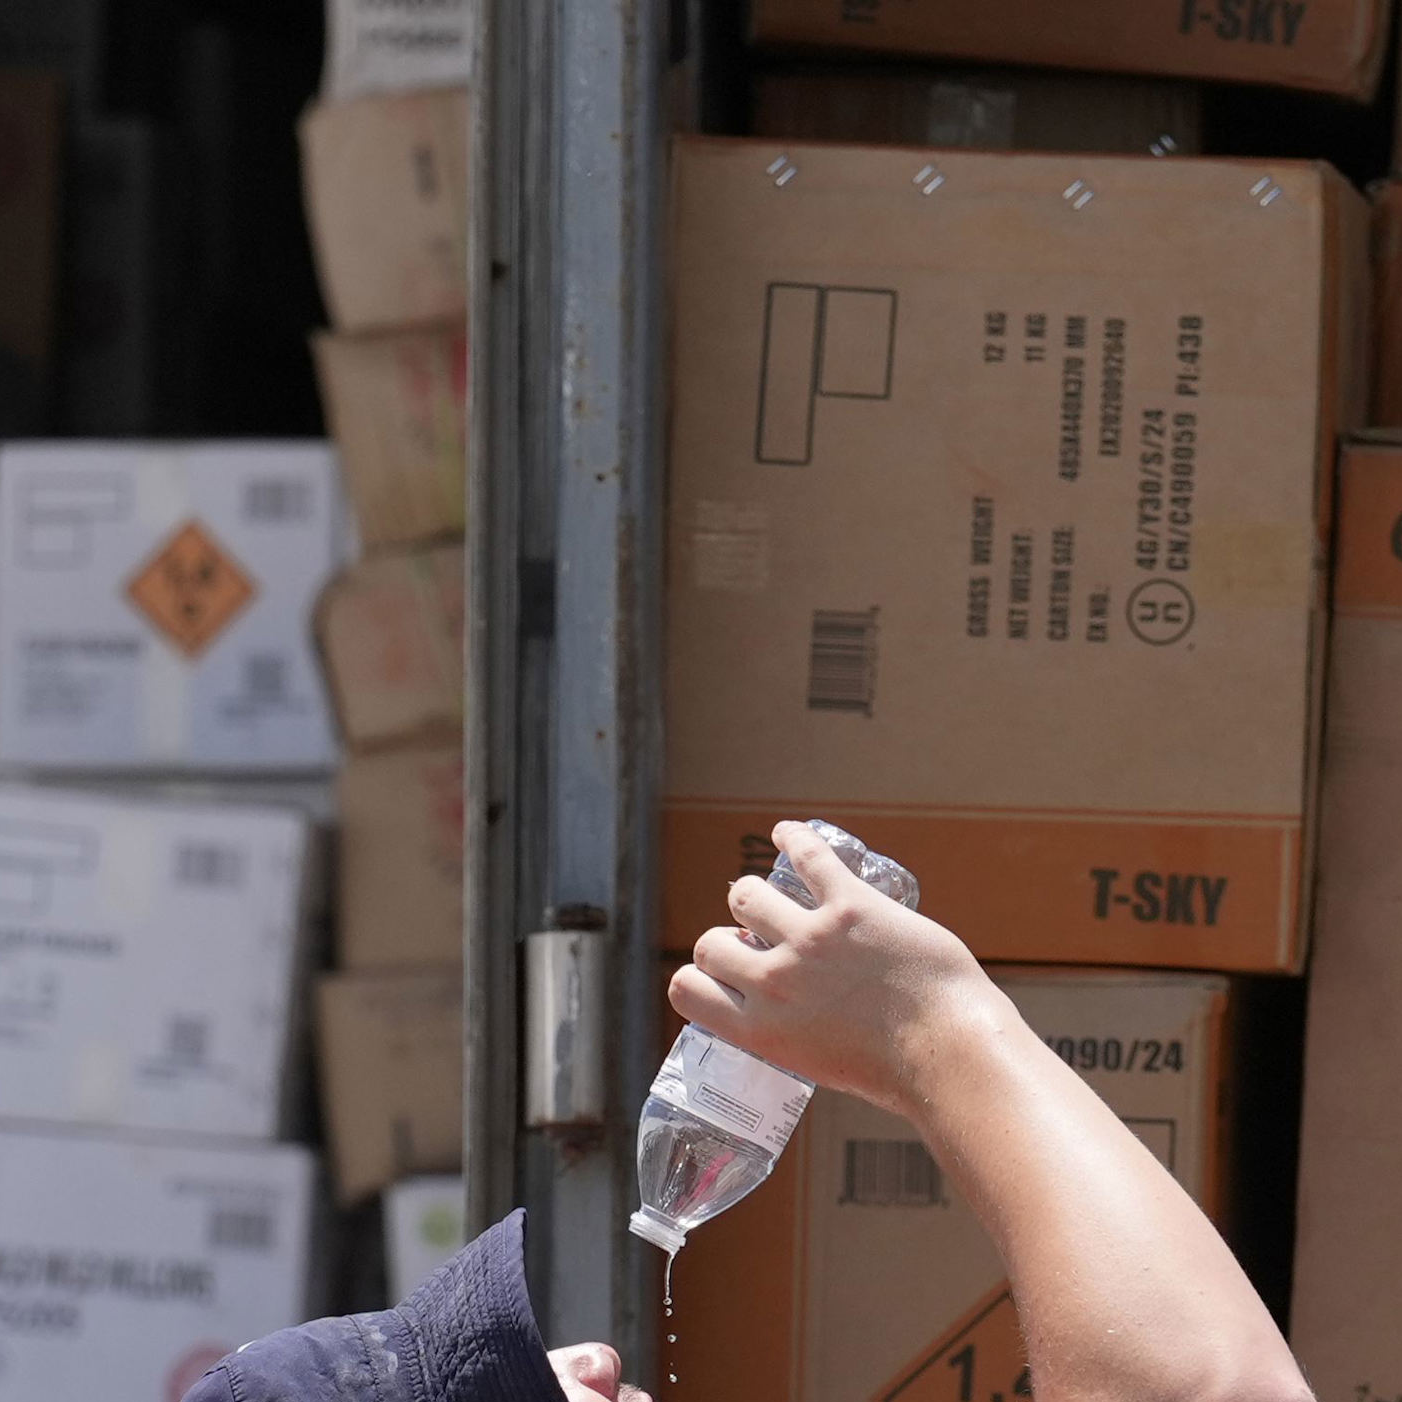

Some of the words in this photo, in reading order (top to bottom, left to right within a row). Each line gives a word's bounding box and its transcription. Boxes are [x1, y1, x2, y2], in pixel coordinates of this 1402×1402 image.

[986, 311, 1007, 337] KG
[1026, 313, 1048, 338] KG
[1064, 315, 1087, 349] MM
[984, 343, 1006, 364] 12
[1025, 346, 1046, 364] 11
[1135, 408, 1165, 572] 4G/Y30/S/24
[966, 577, 990, 639] GROSS
[1047, 570, 1073, 642] CARTON
[1008, 608, 1030, 640] NET
[1088, 867, 1228, 927] T-SKY
[1048, 1034, 1184, 1074] 090/24
